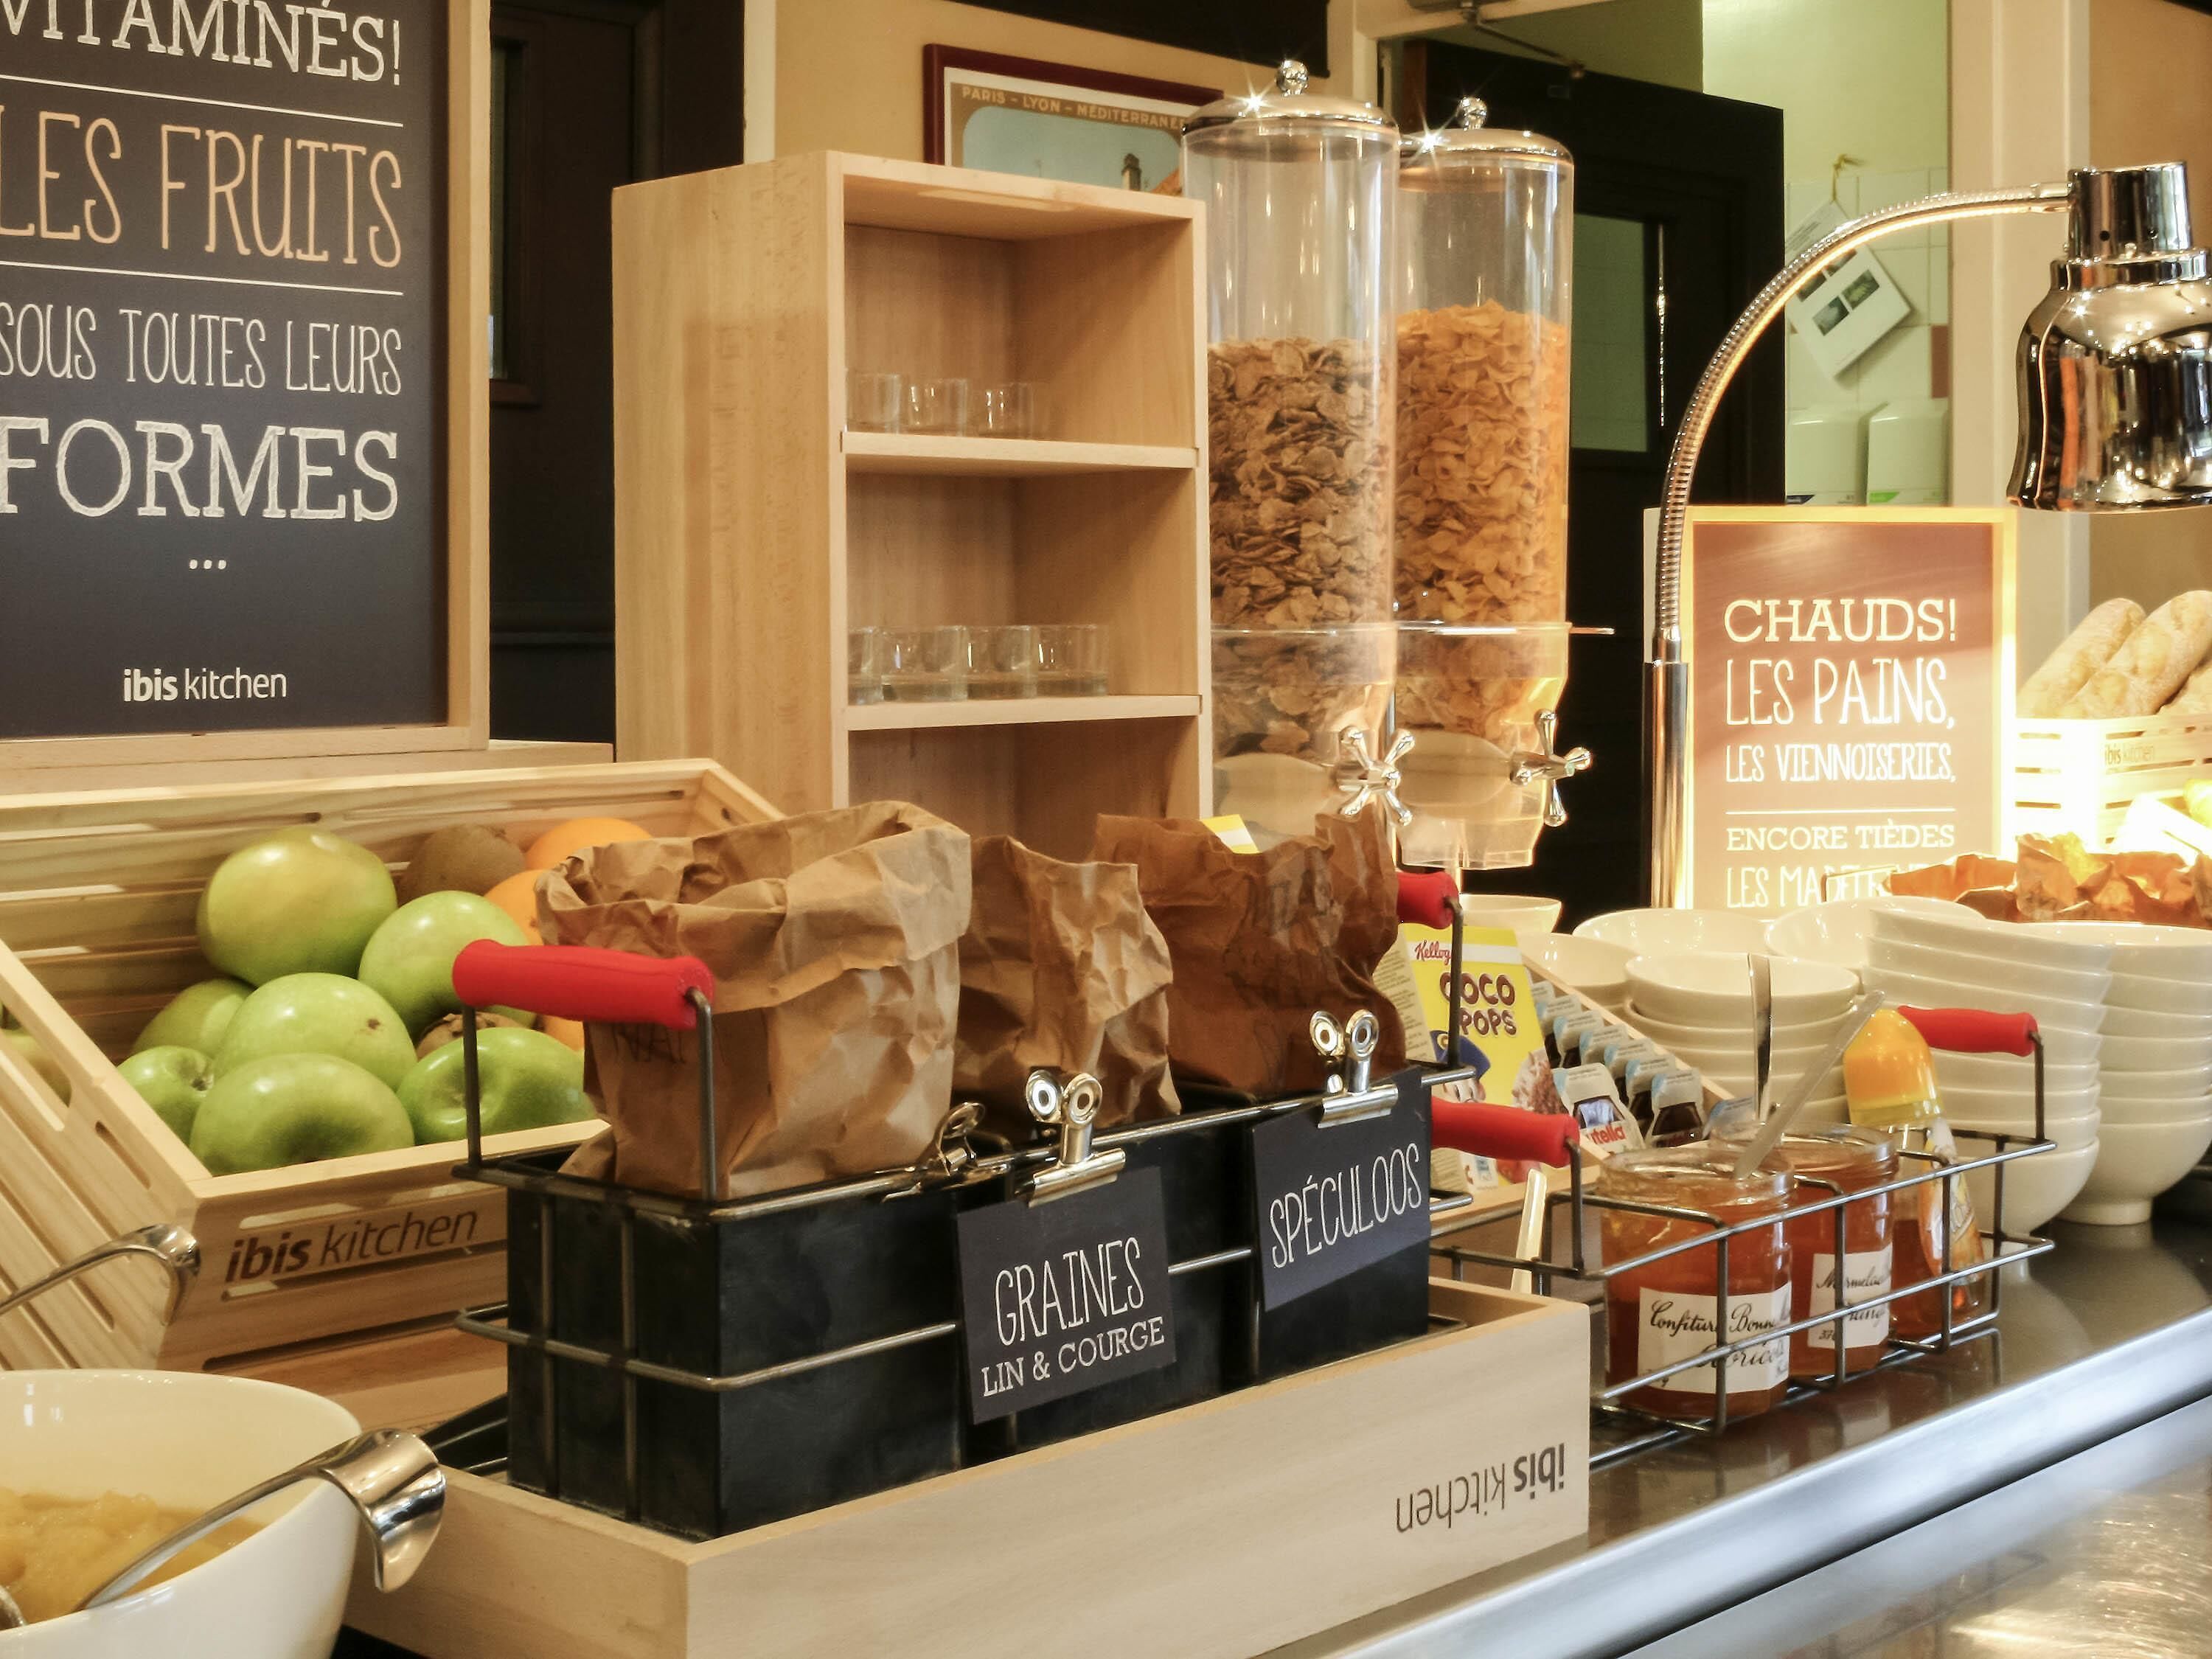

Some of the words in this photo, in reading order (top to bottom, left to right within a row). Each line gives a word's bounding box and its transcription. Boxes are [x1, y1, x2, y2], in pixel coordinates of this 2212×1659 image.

[962, 86, 1006, 105] PARIS
[1023, 94, 1060, 113] LYON
[0, 105, 122, 244] LES
[161, 124, 402, 268] FRUITS
[0, 302, 97, 380] SOUS
[119, 308, 266, 389] TOUTES
[286, 320, 402, 396] LEURS
[0, 416, 398, 522] FORMES
[1724, 598, 1956, 642] CHAUDS!
[123, 668, 178, 702] ibis
[184, 667, 287, 700] kitchen
[1726, 658, 1794, 726] LES
[1813, 657, 1955, 730] PAINS,
[1725, 745, 1764, 782] LES
[1774, 742, 1956, 782] VIENNOISERIES,
[1726, 827, 1847, 852] ENCORE
[1855, 818, 1955, 849] TIÈDES
[1726, 865, 1769, 908] LES
[1459, 1008, 1517, 1035] POPS
[1269, 1142, 1422, 1269] SPÉCULOOS
[225, 1231, 313, 1283] ibis
[319, 1210, 478, 1267] kitchen
[994, 1237, 1145, 1346] GRAINES
[1650, 1300, 1718, 1337] Confitur
[981, 1356, 1026, 1397] LIN
[1032, 1350, 1051, 1382] &
[1057, 1315, 1165, 1374] COURGE
[1397, 1463, 1505, 1533] kitchen
[1514, 1443, 1565, 1500] ibis
